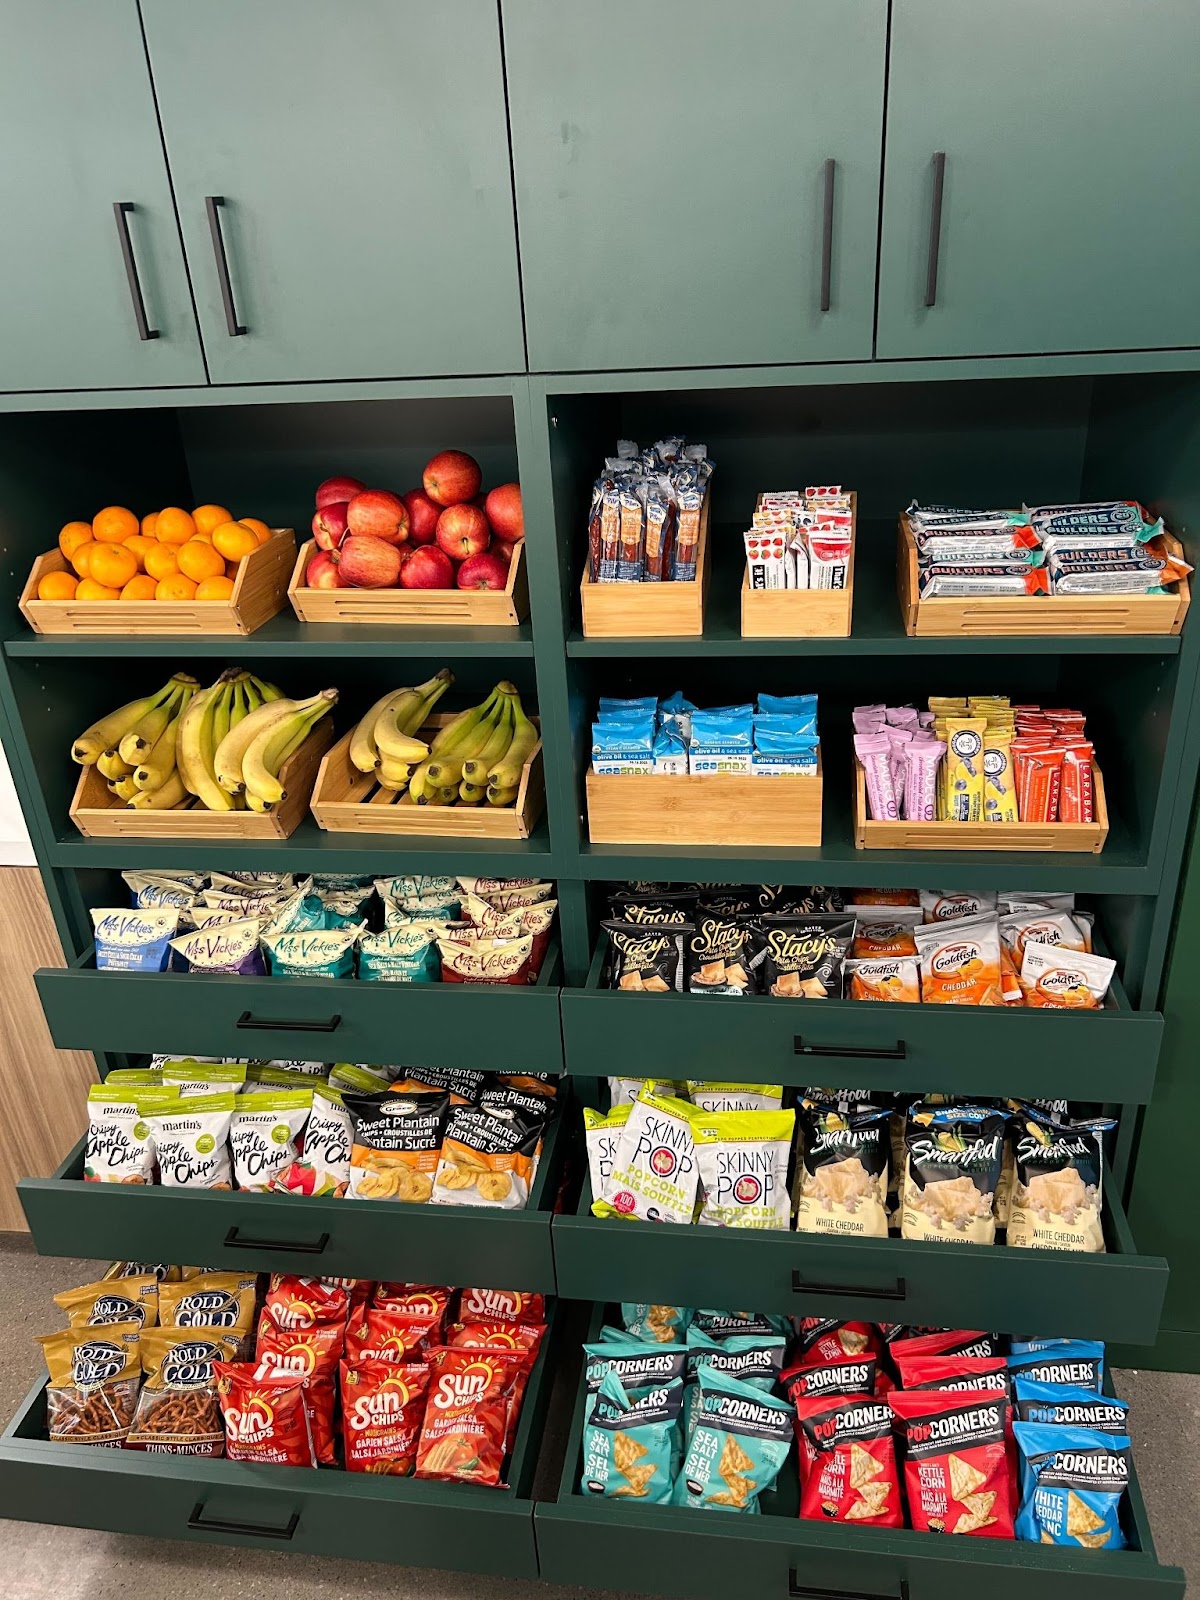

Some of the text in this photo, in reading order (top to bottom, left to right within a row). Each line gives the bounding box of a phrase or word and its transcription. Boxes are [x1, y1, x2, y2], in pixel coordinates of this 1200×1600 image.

[1046, 525, 1118, 534] BUILDERS
[932, 552, 1005, 561] BUILDERS
[1058, 550, 1129, 560] BUILDERS
[932, 567, 1005, 575] BUILDERS
[1062, 564, 1137, 573] BUILDERS
[614, 752, 622, 760] oil
[694, 747, 711, 755] olive
[695, 762, 747, 771] seasnax
[1050, 772, 1061, 821] LARABA
[139, 884, 160, 906] Miss
[391, 877, 413, 897] Miss
[412, 876, 449, 895] Vickie's
[500, 893, 537, 912] Vickie's
[938, 902, 978, 918] Goldfish
[97, 914, 155, 938] Miss Vickie's
[476, 926, 513, 940] Vickie's
[388, 928, 425, 948] Vickie's
[690, 919, 753, 953] Stacy's
[184, 936, 243, 960] Miss Vickie's
[274, 937, 341, 958] Miss Vickie's
[768, 930, 837, 965] Stacy's
[453, 952, 520, 972] Miss Vickie's
[936, 948, 978, 970] Goldfish
[860, 964, 901, 975] Goldfish
[942, 979, 978, 991] CHEDDAR
[404, 1068, 478, 1101] Plantain Sucré
[506, 1091, 548, 1114] Plantain
[238, 1115, 279, 1123] martin's
[309, 1116, 345, 1132] Crispy
[357, 1115, 440, 1132] Sweet Plantain
[454, 1108, 486, 1126] Sweet
[90, 1124, 119, 1136] Crispy
[162, 1120, 203, 1132] martin's
[384, 1129, 424, 1137] CROUSTILLES
[304, 1130, 350, 1155] Apple
[404, 1134, 437, 1150] Sucré
[444, 1122, 487, 1150] Plantain
[472, 1126, 510, 1148] CROUSTILLES
[86, 1131, 131, 1159] Apple
[108, 1147, 148, 1167] Chips
[248, 1150, 291, 1176] Chips
[632, 1136, 693, 1184] POP
[174, 1158, 218, 1184] Chips
[626, 1164, 687, 1200] POPCORN
[717, 1174, 774, 1206] POP
[816, 1217, 865, 1233] WHITE CHEDDAR
[924, 1232, 945, 1243] WHITE
[1032, 1228, 1085, 1245] WHITE CHEDDAR
[93, 1300, 129, 1316] ROLD
[180, 1296, 225, 1310] ROLD
[467, 1288, 521, 1315] Sun
[174, 1311, 237, 1328] GOLD
[270, 1302, 316, 1329] Sun
[484, 1308, 516, 1322] CHIPS
[74, 1348, 117, 1362] ROLD
[168, 1346, 208, 1363] ROLD
[820, 1340, 838, 1354] KETTLE
[824, 1347, 842, 1361] CORN
[262, 1350, 313, 1376] Sun
[687, 1351, 772, 1370] POPCORNERS
[74, 1362, 122, 1382] GOLD
[434, 1373, 488, 1410] Sun
[788, 1365, 869, 1402] POPCORNERS
[454, 1391, 484, 1407] CHIPS
[350, 1390, 407, 1431] Sun
[371, 1410, 405, 1426] CHIPS
[1028, 1406, 1126, 1423] POPCORNERS
[225, 1405, 273, 1442] Sun
[814, 1406, 896, 1441] POPCORNER
[907, 1406, 1001, 1443] POPCORNERS
[140, 1434, 166, 1442] CLASSIC
[238, 1427, 275, 1444] CHIPS
[384, 1432, 406, 1446] SALSA
[592, 1430, 610, 1447] SEA
[696, 1430, 719, 1448] SEA
[590, 1442, 610, 1458] SALT
[692, 1441, 717, 1460] SALT
[588, 1454, 610, 1471] SEL
[690, 1454, 712, 1474] SEL
[585, 1465, 609, 1482] DE MER
[684, 1464, 711, 1485] DE MER
[918, 1466, 945, 1479] KETTLE
[836, 1480, 844, 1489] LA
[920, 1478, 946, 1489] CORN
[818, 1486, 844, 1499] MARMITE
[934, 1488, 940, 1502] À
[939, 1492, 947, 1503] LA
[922, 1501, 949, 1514] MARMITE
